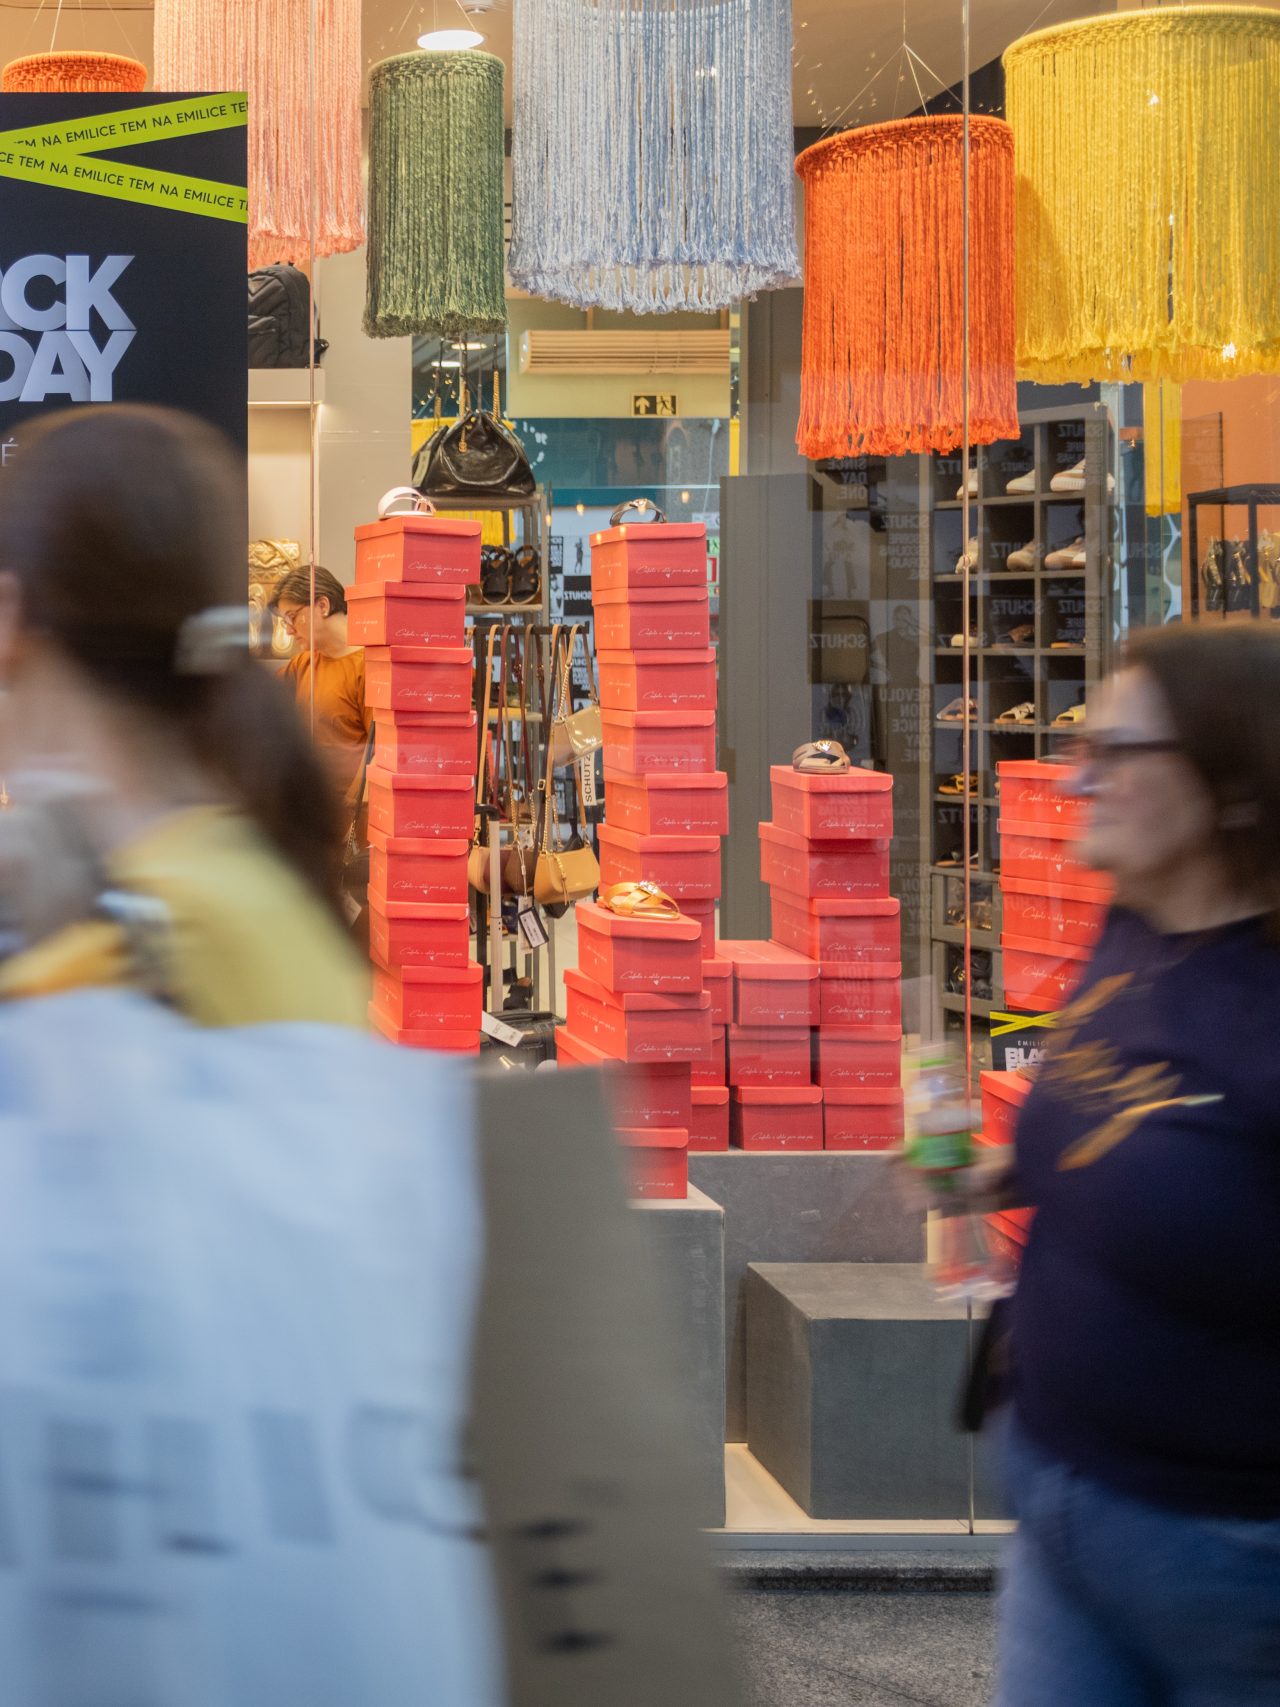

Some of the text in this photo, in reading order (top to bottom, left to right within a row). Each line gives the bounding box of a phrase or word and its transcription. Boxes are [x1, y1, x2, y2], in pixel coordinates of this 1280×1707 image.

[42, 135, 62, 147] NA
[66, 124, 116, 143] EMILICE
[120, 119, 147, 133] TEM
[152, 115, 172, 128] NA
[177, 105, 227, 123] EMILICE
[231, 101, 248, 114] TE
[19, 155, 45, 170] TEM
[49, 162, 69, 175] NA
[74, 166, 124, 186] EMILICE
[129, 177, 155, 192] TEM
[160, 184, 179, 197] NA
[184, 188, 234, 208] EMILICE
[584, 754, 592, 802] SCHUTZ
